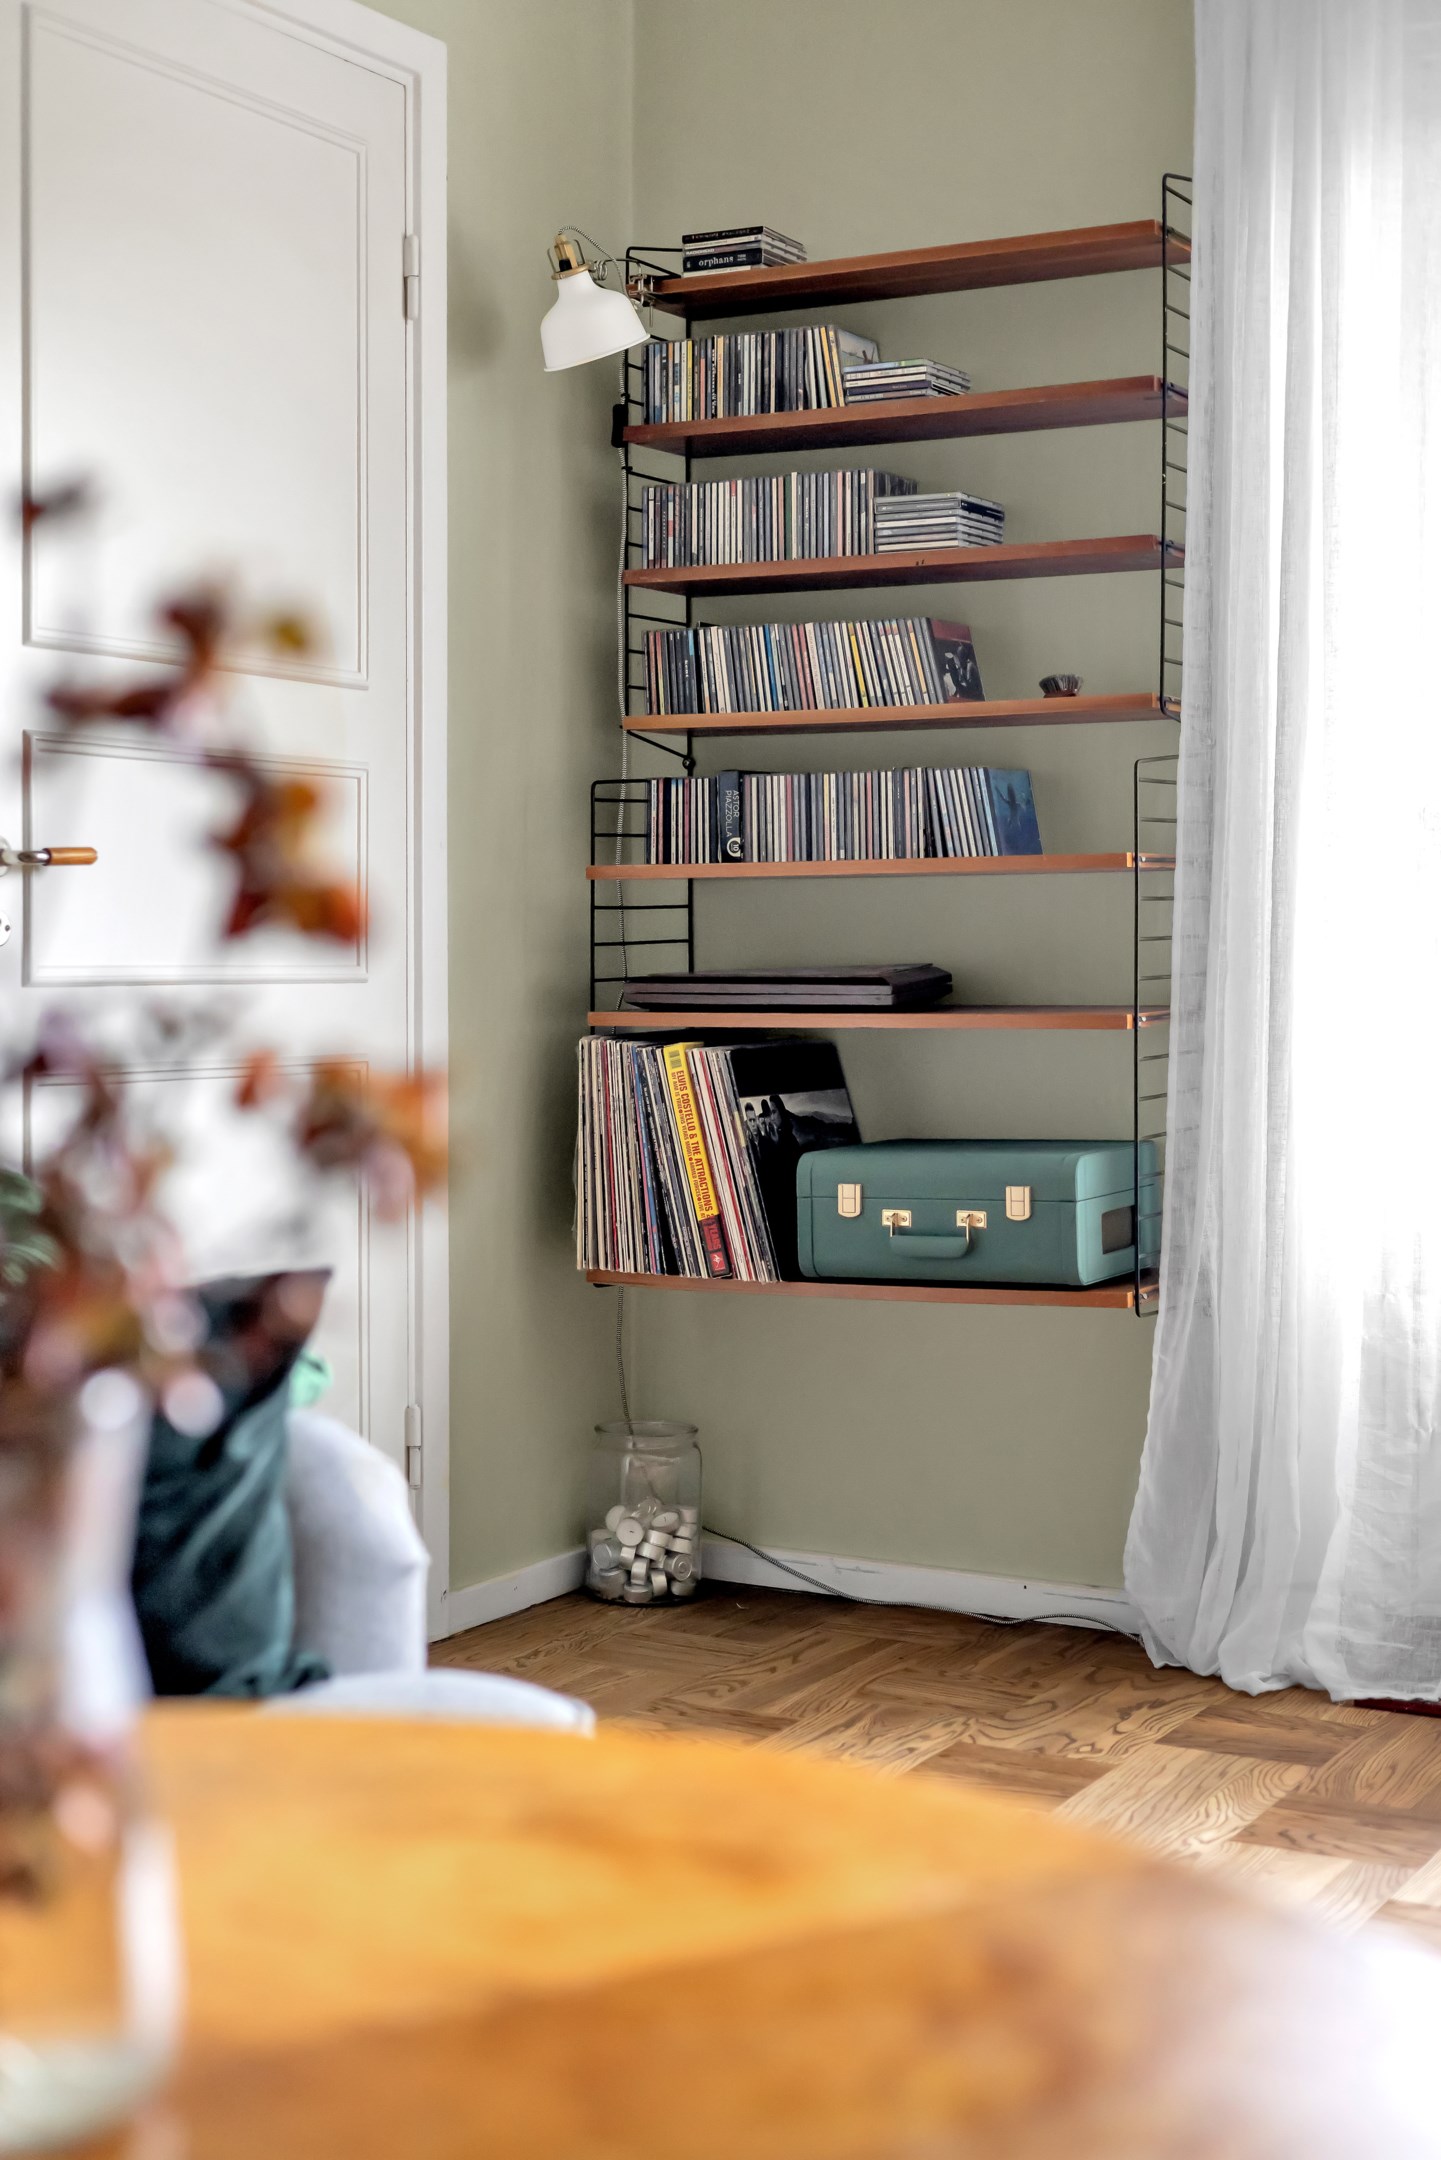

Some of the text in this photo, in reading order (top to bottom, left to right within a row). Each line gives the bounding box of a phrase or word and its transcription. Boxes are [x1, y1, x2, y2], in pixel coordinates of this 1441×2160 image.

[698, 256, 734, 267] orphans
[725, 790, 733, 837] PIAZZOLLA
[733, 843, 739, 852] 10
[676, 1070, 688, 1092] ELVIS
[681, 1093, 696, 1132] COSTELLO
[691, 1141, 702, 1157] THE
[695, 1158, 713, 1212] ATTRACTIONS
